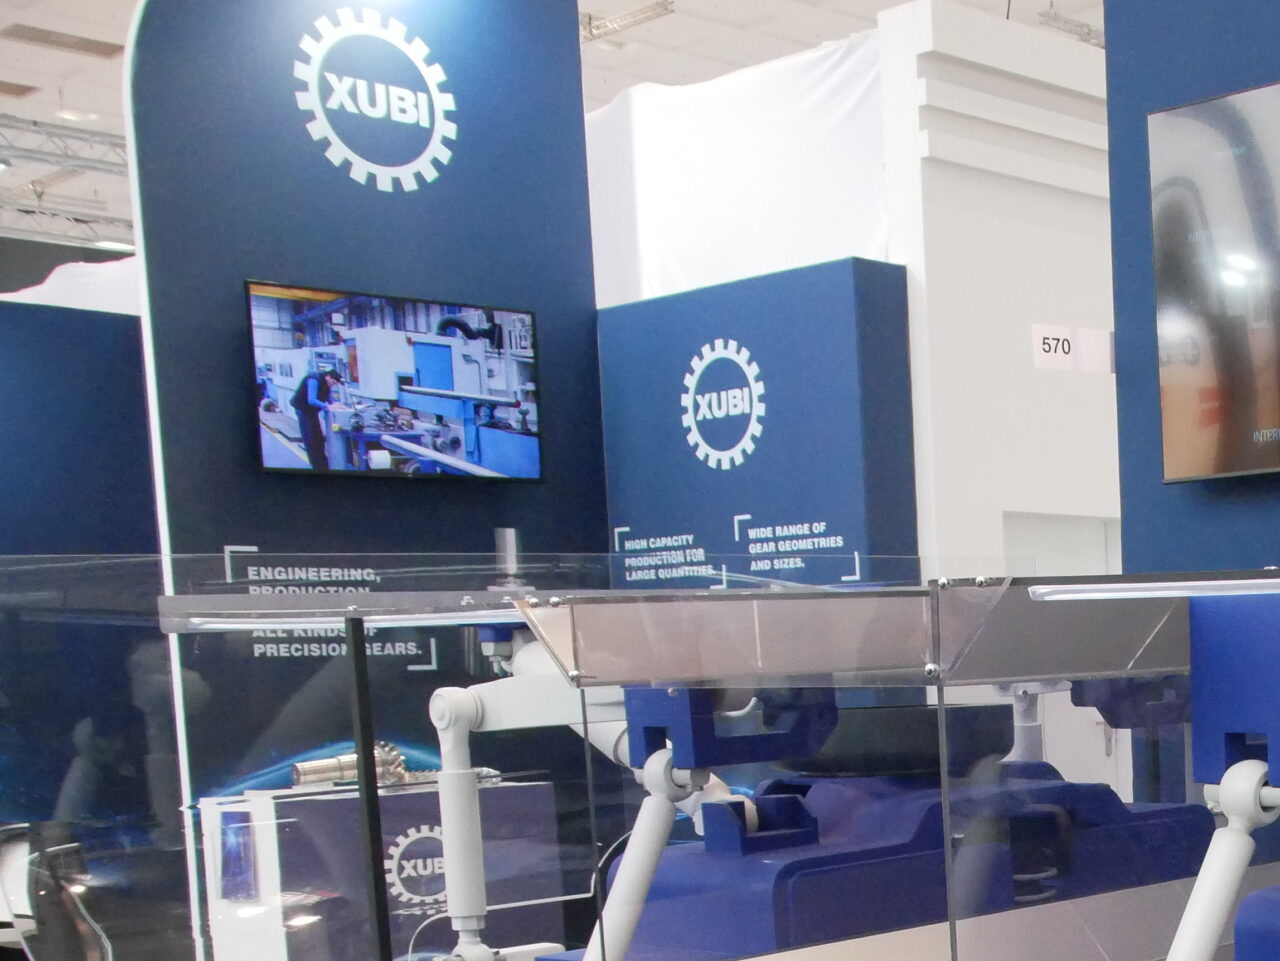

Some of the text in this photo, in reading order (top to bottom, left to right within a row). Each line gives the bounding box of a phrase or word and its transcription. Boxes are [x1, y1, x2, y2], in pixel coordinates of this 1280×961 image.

[323, 72, 430, 128] XUBI
[1042, 337, 1071, 355] 570
[695, 387, 751, 421] XUBI
[748, 522, 827, 539] WIDE RANGE OF
[624, 534, 694, 551] HIGH CAPACITY
[749, 536, 844, 554] GEAR GEOMETRIES
[624, 548, 705, 567] PRODUCTION FOR
[750, 558, 806, 571] AND SIZES.
[247, 566, 381, 583] ENGINEERING,
[625, 565, 716, 581] LARGE QUANTITIES.
[400, 857, 445, 878] XUB
